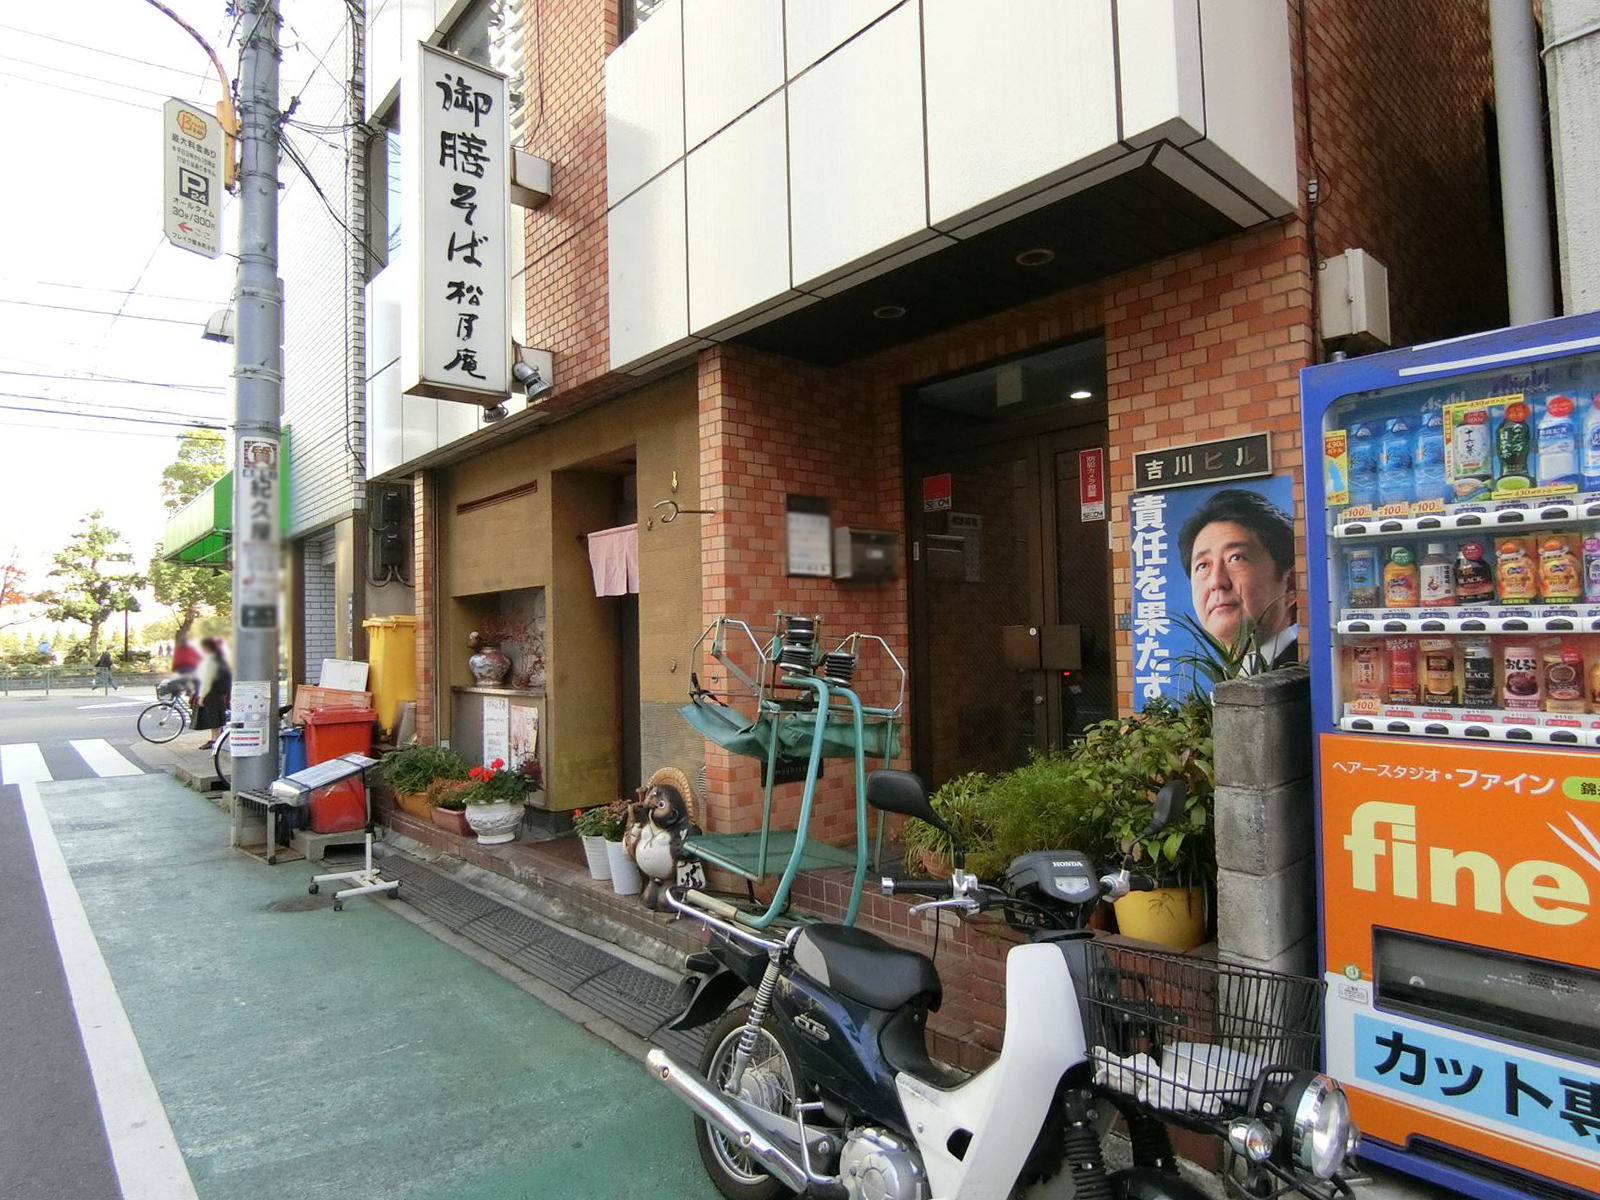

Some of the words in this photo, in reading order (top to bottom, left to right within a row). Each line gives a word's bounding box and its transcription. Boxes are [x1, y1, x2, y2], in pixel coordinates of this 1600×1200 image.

[182, 171, 207, 193] P
[436, 73, 493, 268] 御膳そば
[191, 191, 207, 203] 24
[194, 228, 211, 240] ここ
[1144, 446, 1255, 481] 吉川ビル
[1131, 494, 1171, 699] 責任を果たす
[1580, 781, 1600, 798] 錦
[1343, 800, 1591, 927] fine
